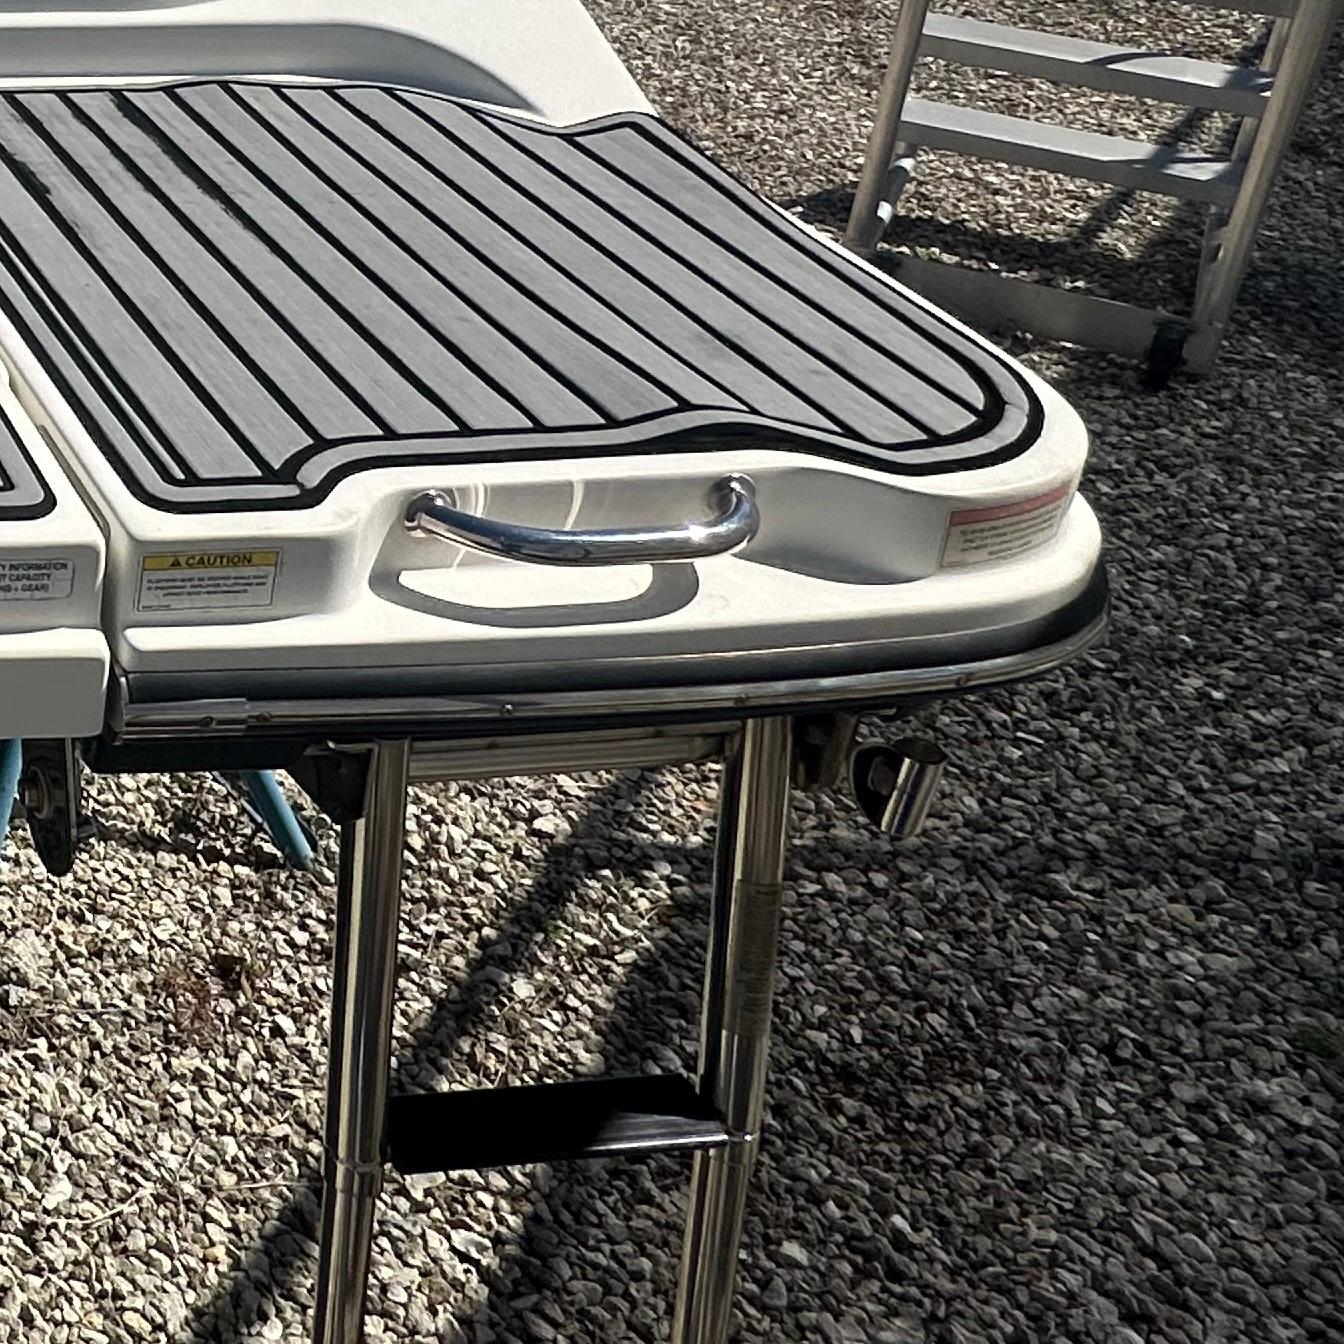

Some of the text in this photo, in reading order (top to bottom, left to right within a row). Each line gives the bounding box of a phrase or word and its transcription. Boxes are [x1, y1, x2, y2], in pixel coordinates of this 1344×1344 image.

[185, 554, 253, 567] CAUTION
[8, 562, 68, 571] INFORMATION
[9, 572, 52, 582] CAPACITY
[21, 583, 50, 593] GEAR)
